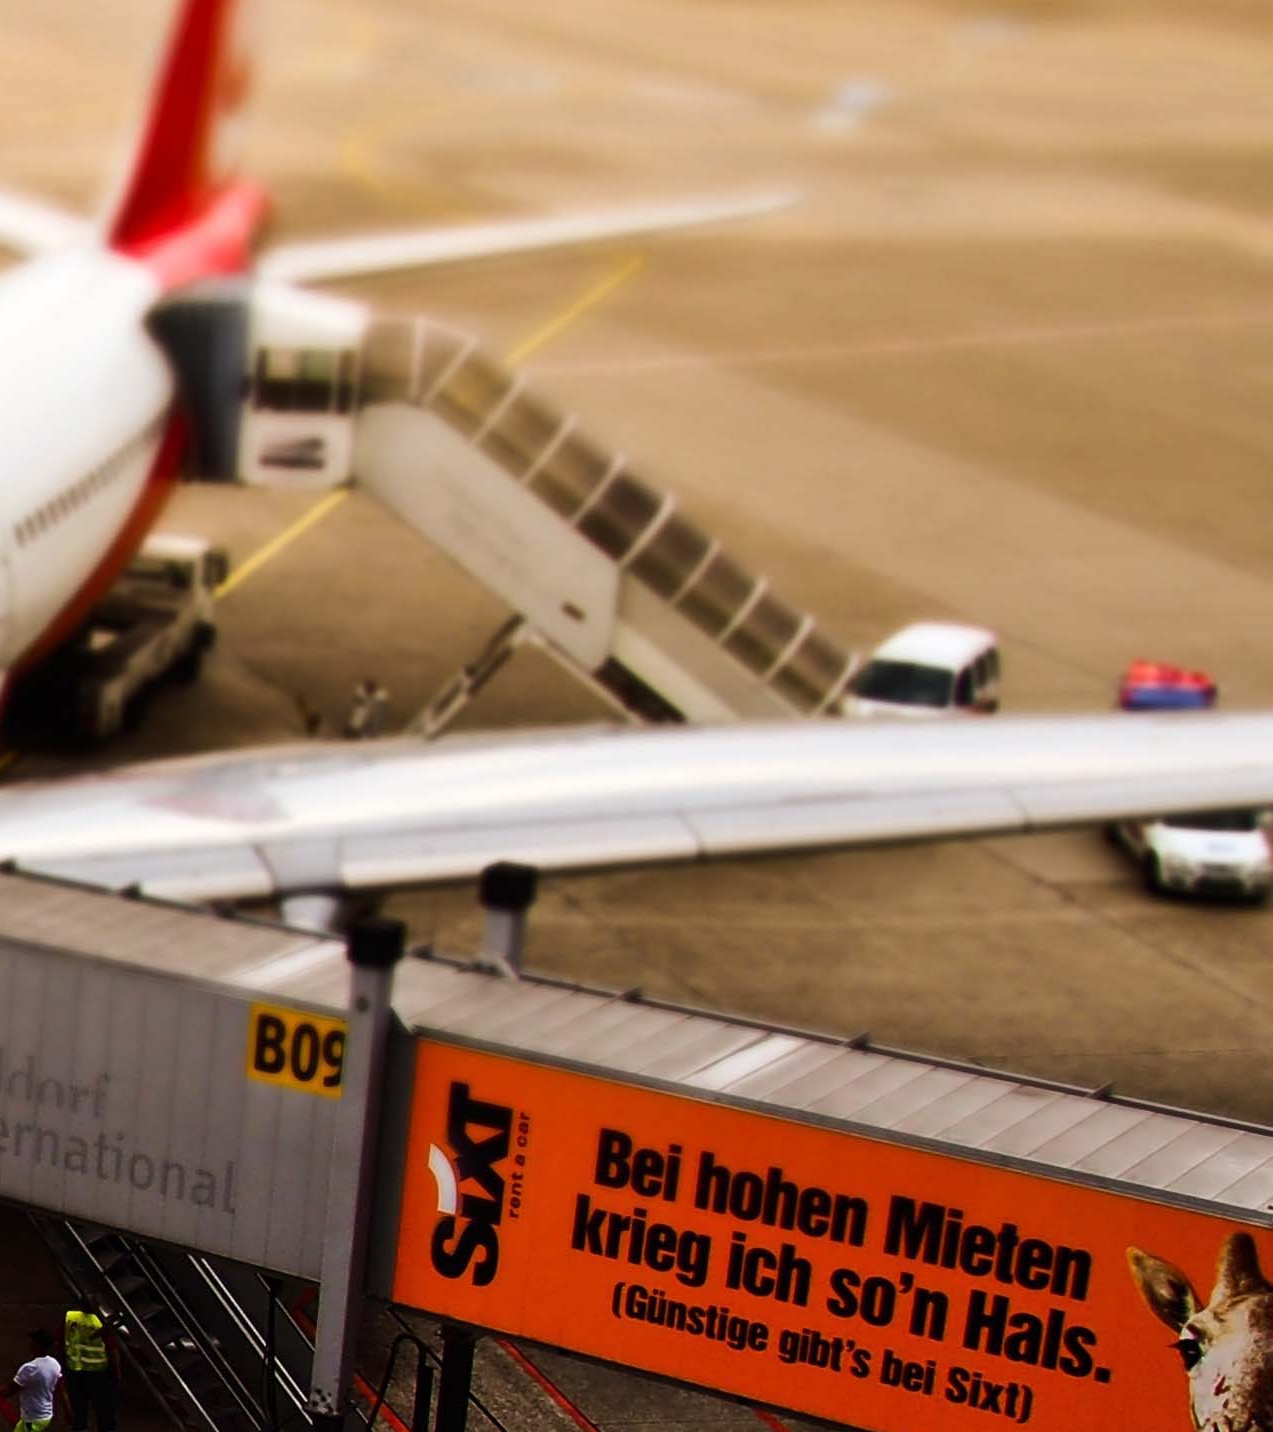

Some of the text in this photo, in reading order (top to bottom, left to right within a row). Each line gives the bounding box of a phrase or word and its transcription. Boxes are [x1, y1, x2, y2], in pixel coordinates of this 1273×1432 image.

[254, 1013, 346, 1088] B09
[508, 1111, 531, 1219] rent a car
[594, 1127, 1093, 1302] Bei hohen Mieten
[571, 1193, 1113, 1385] krieg ich so'n Hals.
[611, 1281, 1035, 1425] (Günstige gibt's bei Sixt)
